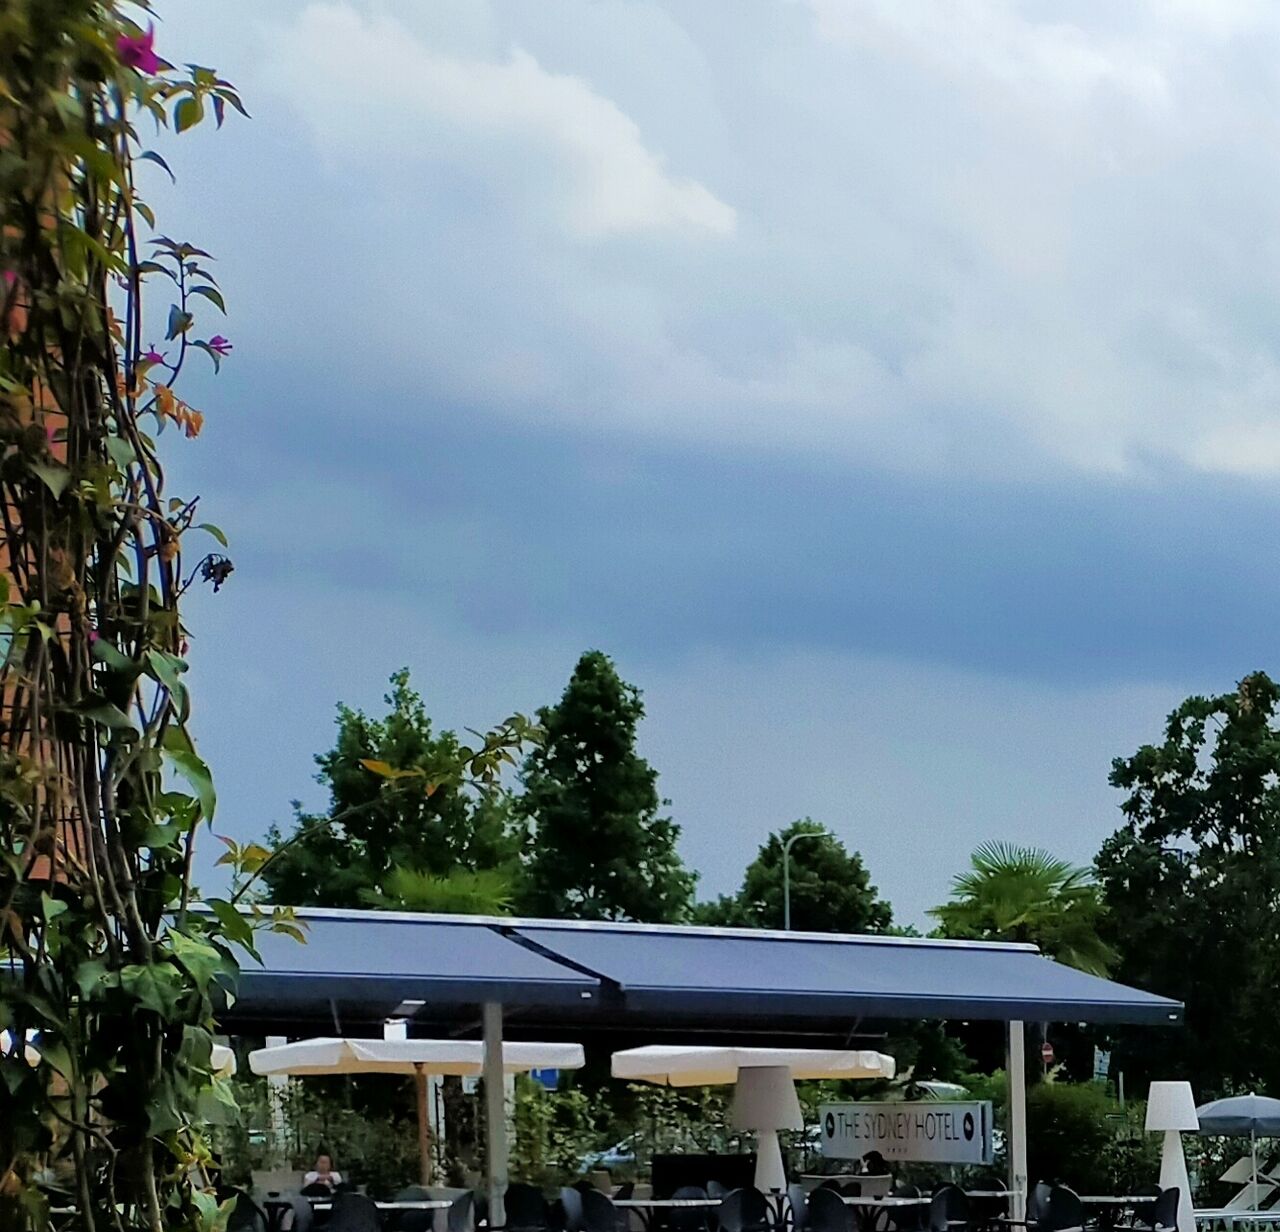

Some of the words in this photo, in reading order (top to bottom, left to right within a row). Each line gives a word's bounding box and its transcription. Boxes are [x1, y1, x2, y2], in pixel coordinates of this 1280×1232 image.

[837, 1112, 860, 1139] THE
[864, 1112, 911, 1140] SYDNEY
[915, 1112, 960, 1141] HOTEL
